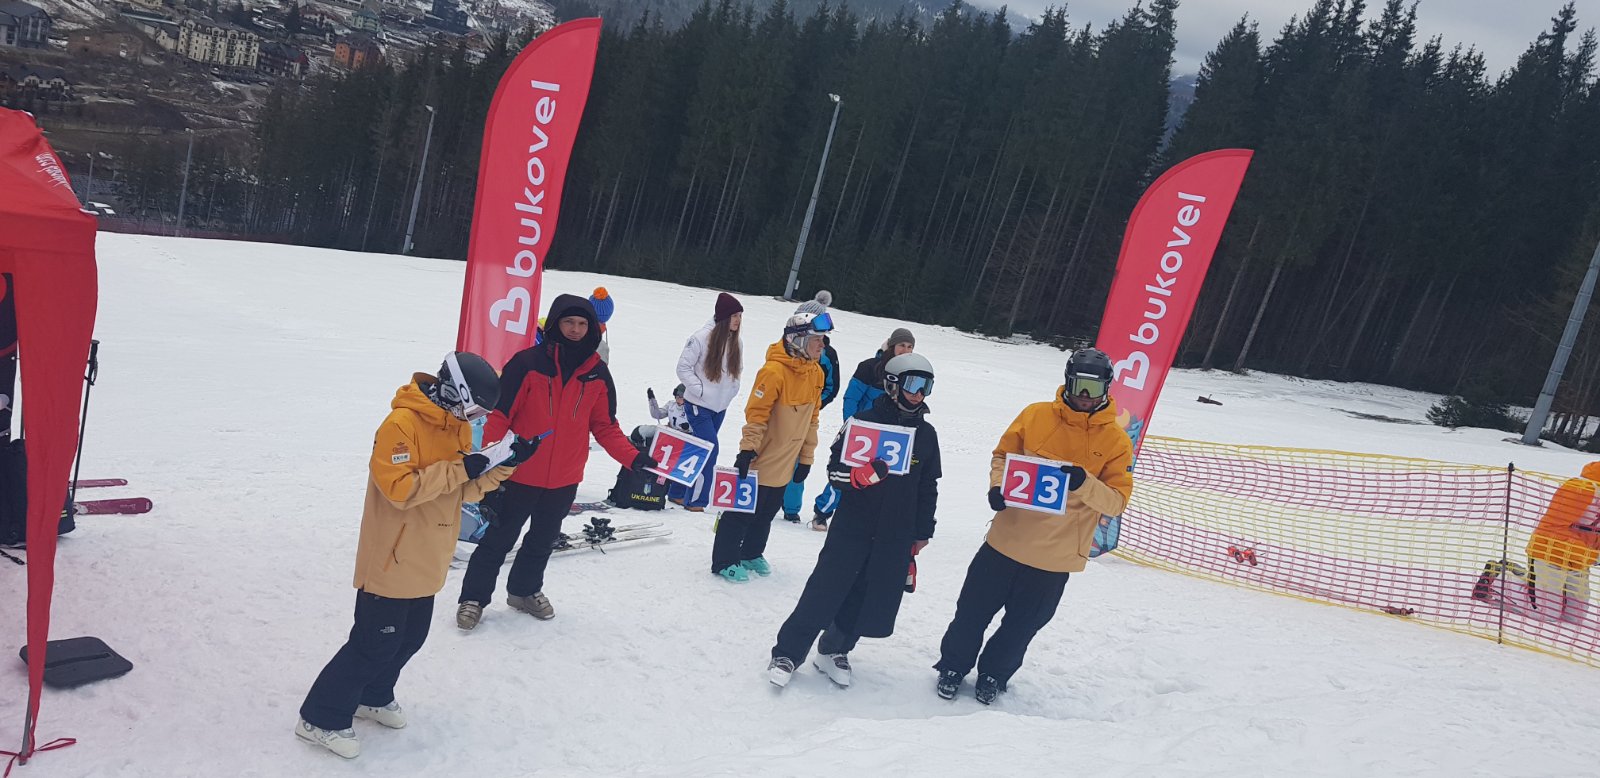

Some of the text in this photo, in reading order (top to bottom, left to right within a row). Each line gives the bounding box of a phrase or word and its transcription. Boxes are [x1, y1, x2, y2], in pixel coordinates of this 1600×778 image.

[505, 80, 560, 278] bukovel
[1130, 191, 1206, 345] bukovel
[631, 493, 660, 503] UKRAINE
